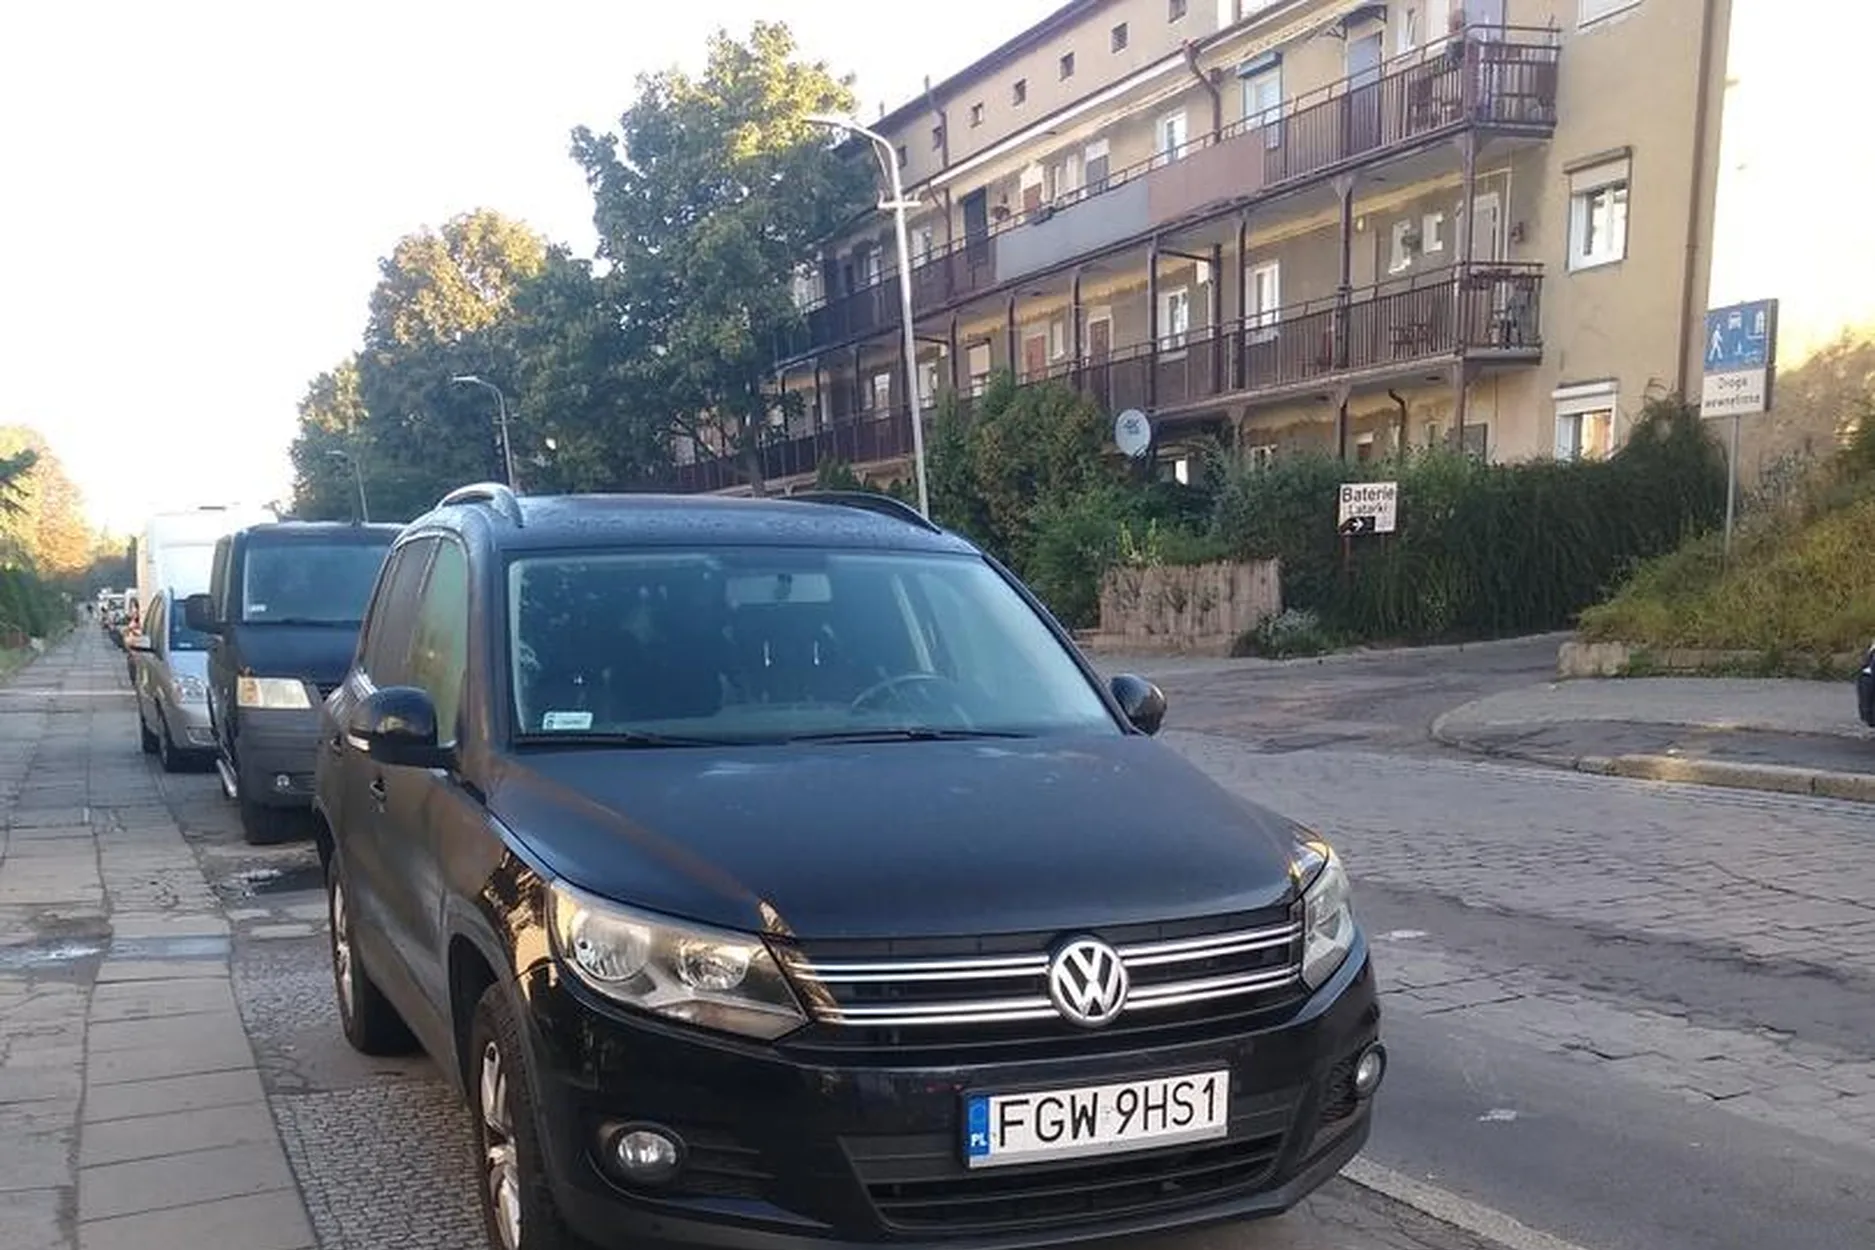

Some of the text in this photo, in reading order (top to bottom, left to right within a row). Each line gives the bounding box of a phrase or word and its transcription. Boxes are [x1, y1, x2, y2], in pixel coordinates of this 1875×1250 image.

[1342, 485, 1394, 503] Baterie
[999, 1078, 1216, 1148] FGW 9HS1
[971, 1134, 988, 1148] PL
